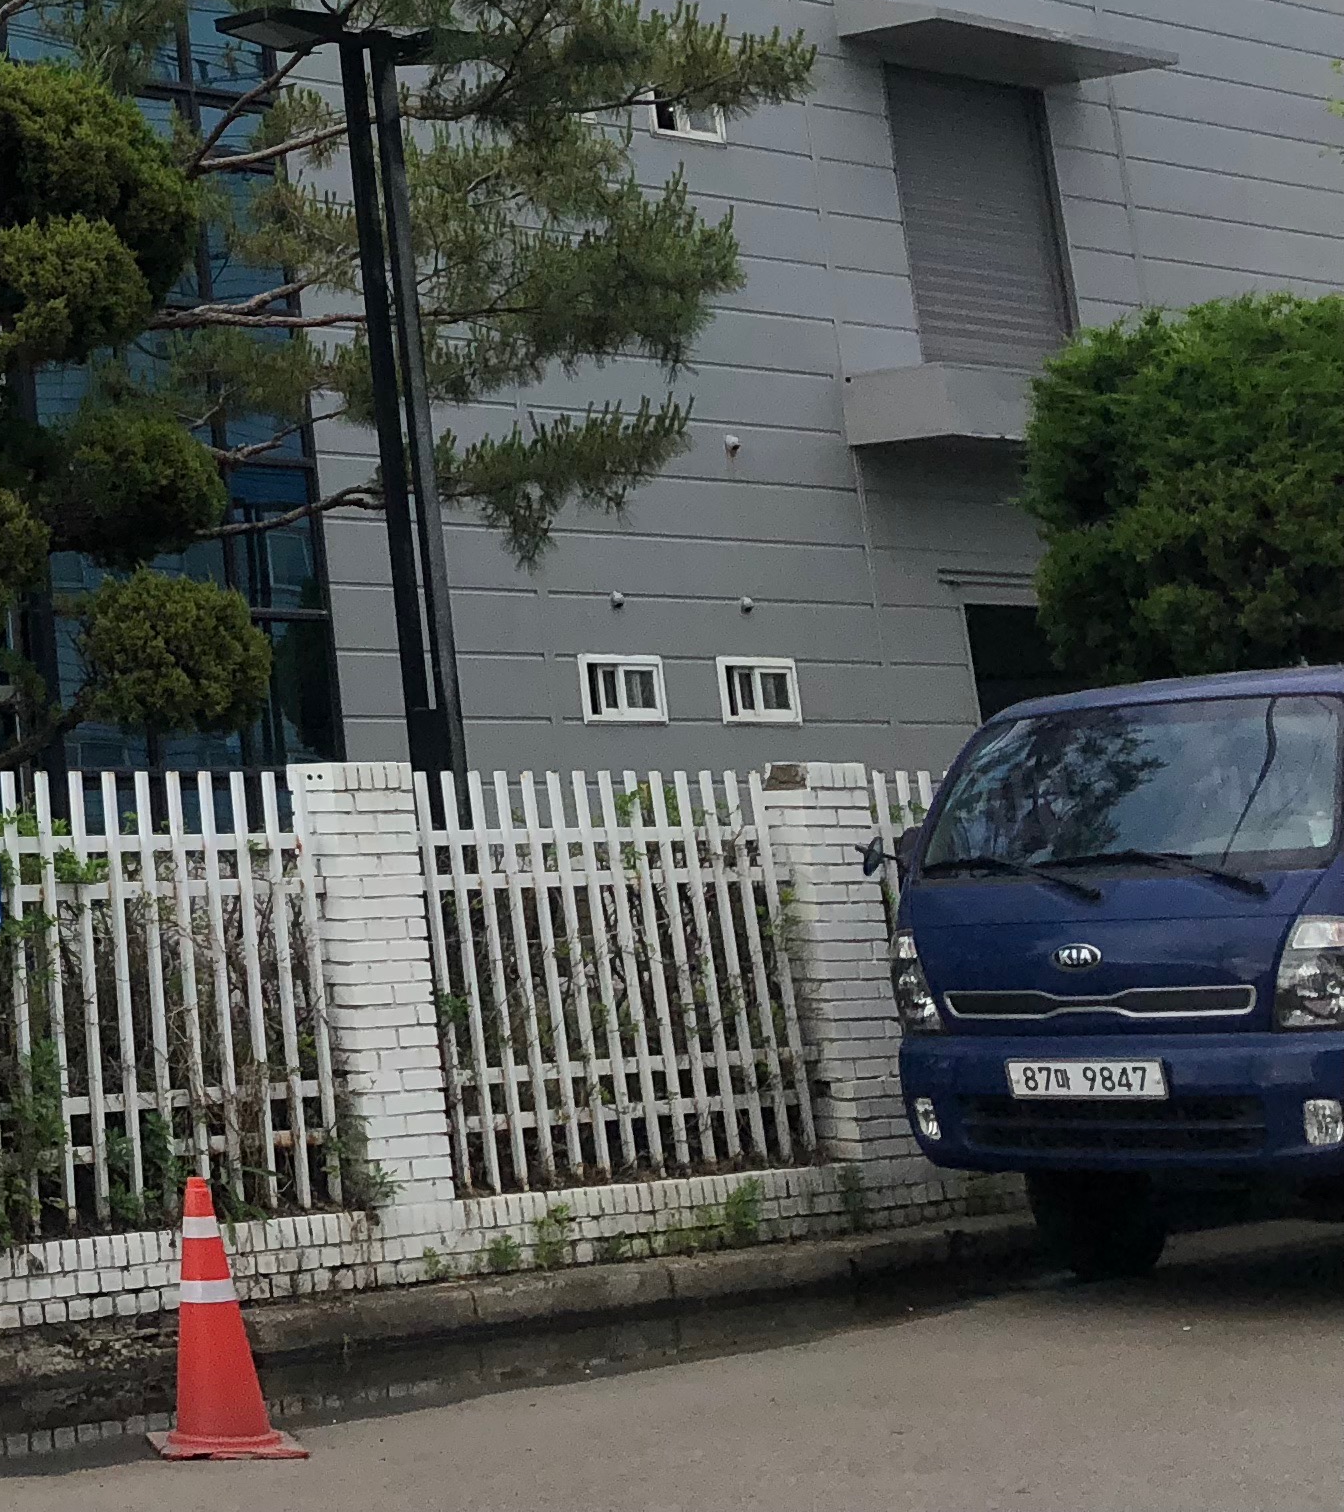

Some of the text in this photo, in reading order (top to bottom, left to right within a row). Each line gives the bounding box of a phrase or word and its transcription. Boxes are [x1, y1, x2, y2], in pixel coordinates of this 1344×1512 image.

[1058, 948, 1092, 965] KIA
[1023, 1066, 1147, 1092] 87마 9847
